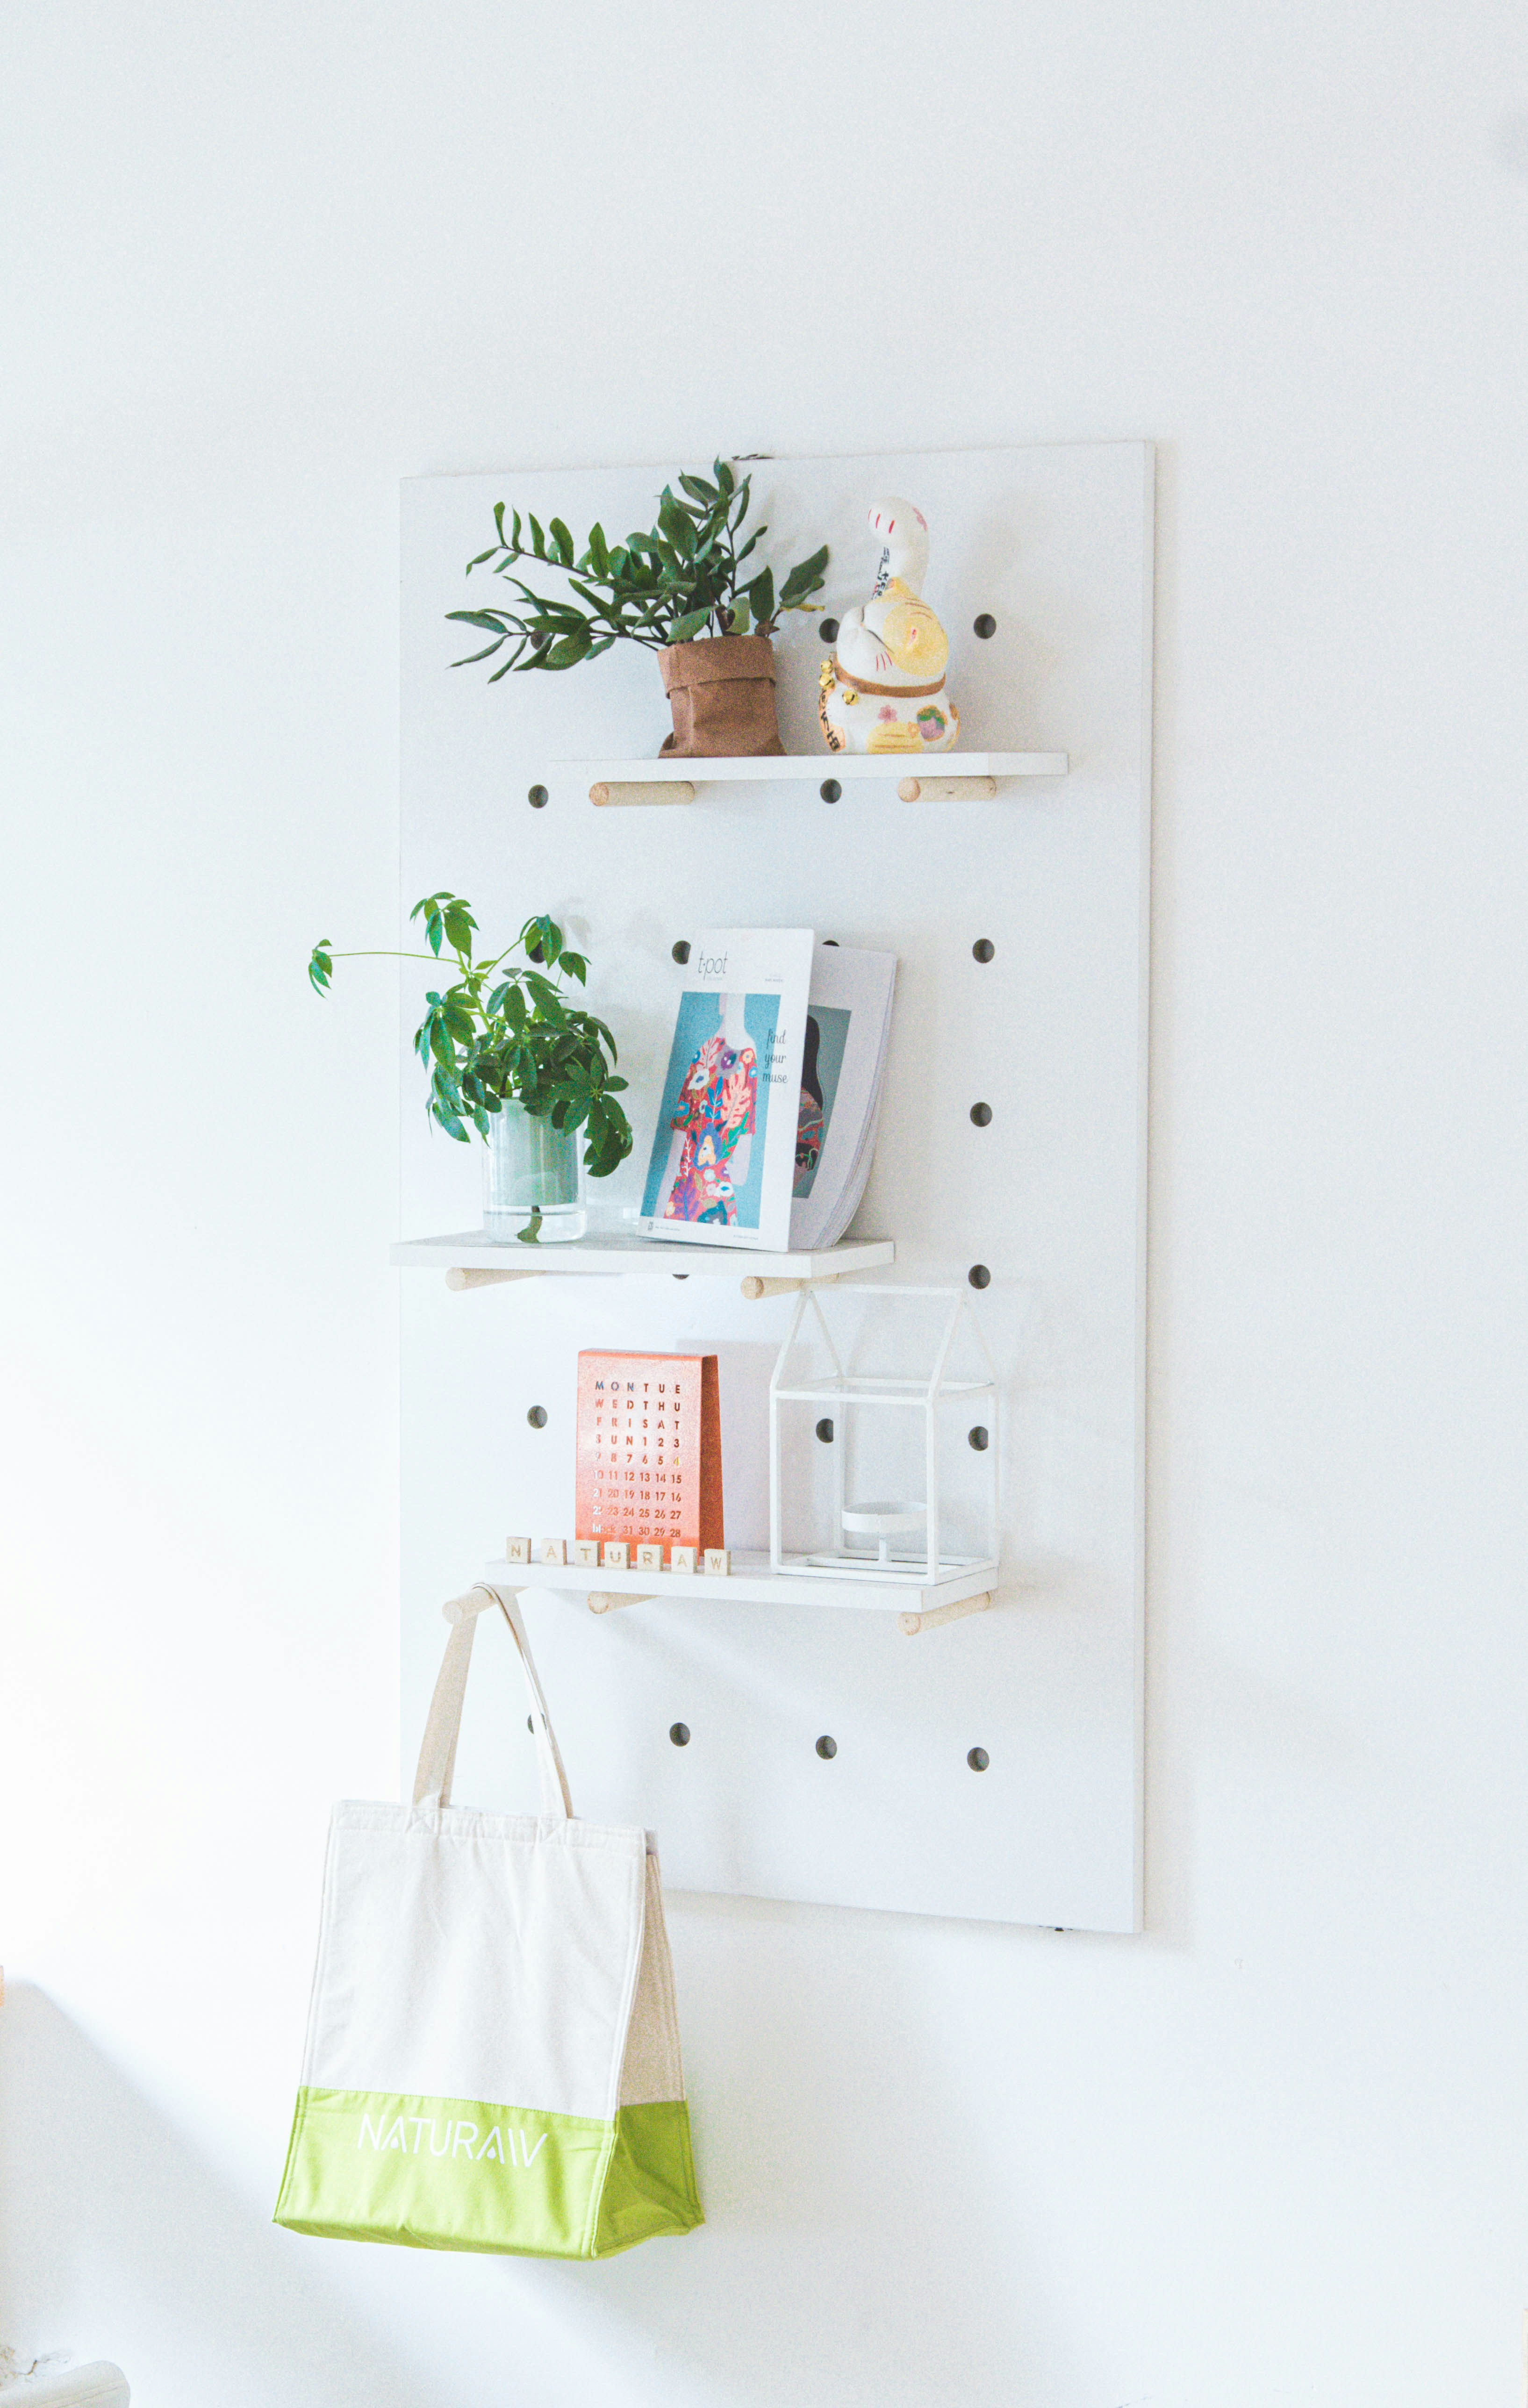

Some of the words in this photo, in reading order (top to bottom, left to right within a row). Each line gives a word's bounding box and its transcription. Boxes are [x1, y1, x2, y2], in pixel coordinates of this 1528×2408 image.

[767, 1028, 786, 1050] find
[764, 1054, 786, 1069] your
[762, 1073, 788, 1083] muse
[595, 1381, 634, 1392] MON
[644, 1383, 681, 1394] TUE
[595, 1398, 634, 1410] WED
[643, 1401, 681, 1412] THU
[596, 1417, 631, 1428] FRI
[643, 1419, 680, 1430] SAT
[596, 1434, 633, 1446] SUN
[643, 1437, 647, 1447] 1
[658, 1438, 664, 1447] 2
[674, 1439, 680, 1448] 3
[611, 1453, 617, 1462] 8
[627, 1454, 633, 1463] 7
[642, 1455, 648, 1464] 6
[658, 1455, 663, 1465] 5
[673, 1456, 679, 1466] 4
[594, 1470, 604, 1480] 10
[609, 1470, 617, 1481] 11
[624, 1471, 635, 1481] 12
[640, 1472, 650, 1482] 13
[655, 1473, 666, 1483] 14
[671, 1474, 682, 1484] 15
[593, 1488, 603, 1498] 21
[608, 1488, 619, 1498] 20
[624, 1490, 635, 1499] 19
[640, 1491, 650, 1500] 18
[655, 1491, 666, 1501] 17
[671, 1492, 682, 1502] 16
[593, 1505, 603, 1515] 22
[608, 1506, 619, 1516] 23
[623, 1507, 634, 1517] 24
[638, 1508, 650, 1518] 25
[654, 1509, 666, 1519] 26
[670, 1510, 682, 1520] 27
[623, 1526, 632, 1535] 31
[638, 1526, 650, 1536] 30
[654, 1527, 666, 1537] 29
[670, 1529, 681, 1538] 28
